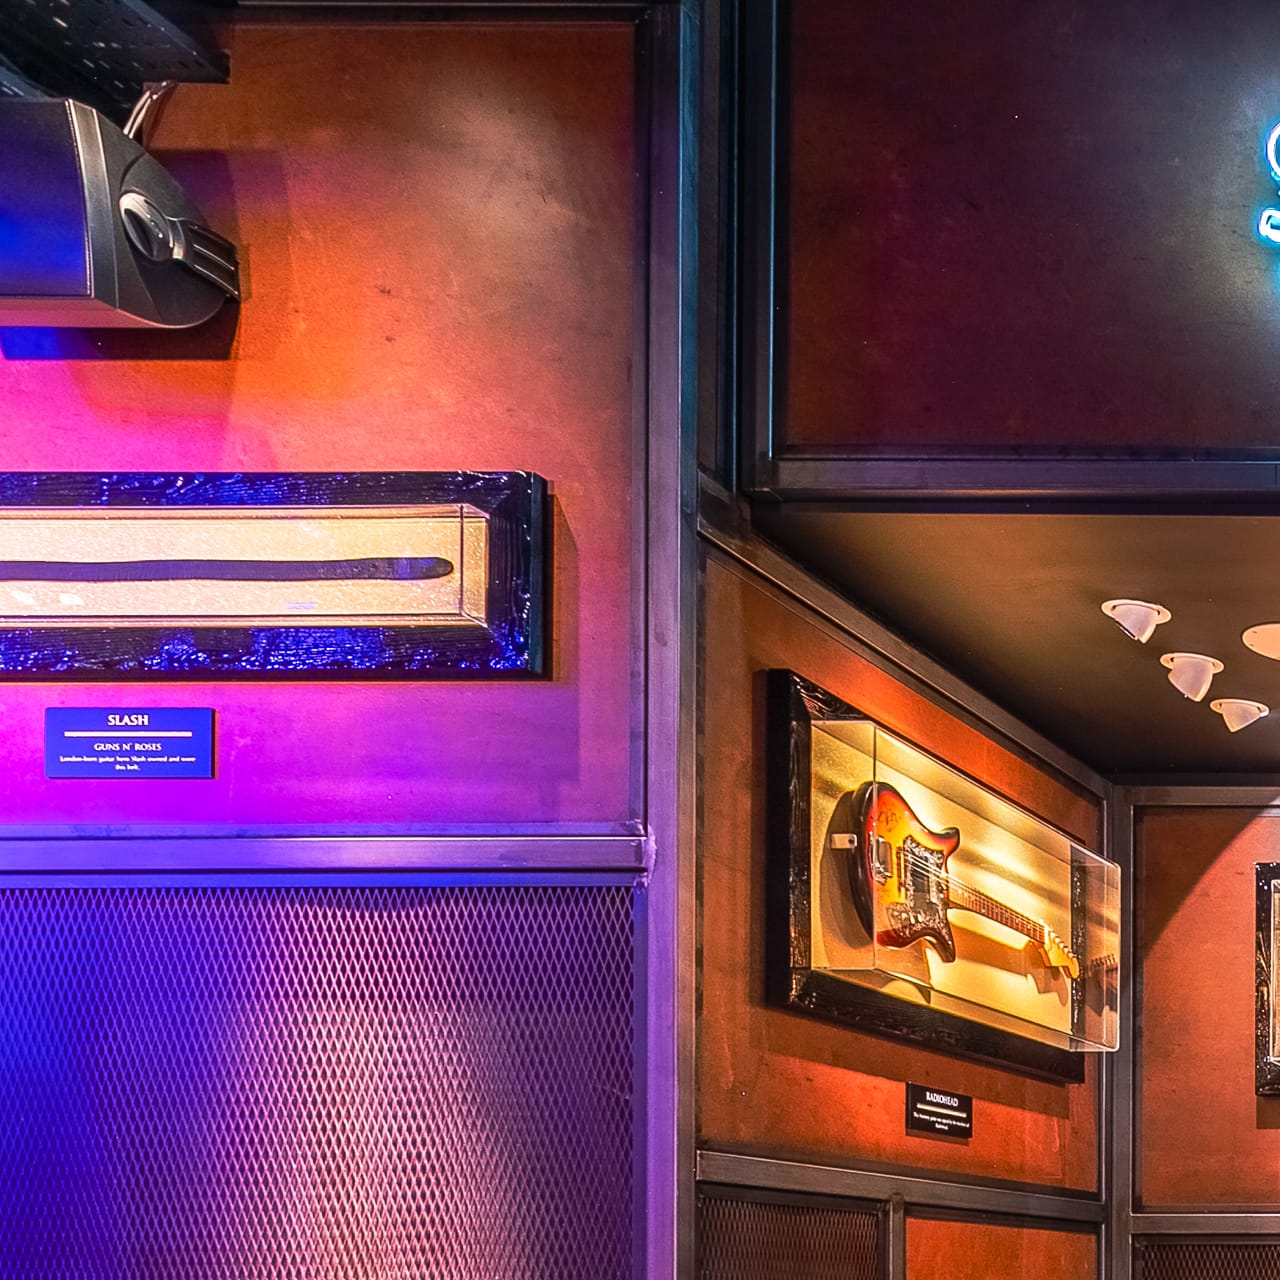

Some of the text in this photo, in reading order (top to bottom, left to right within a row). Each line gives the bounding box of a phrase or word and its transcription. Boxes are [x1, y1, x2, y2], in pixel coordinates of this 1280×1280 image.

[107, 714, 149, 726] SLASH
[94, 743, 120, 751] GUNS
[134, 742, 162, 751] ROSES
[926, 1091, 959, 1107] RADIOHEAD
